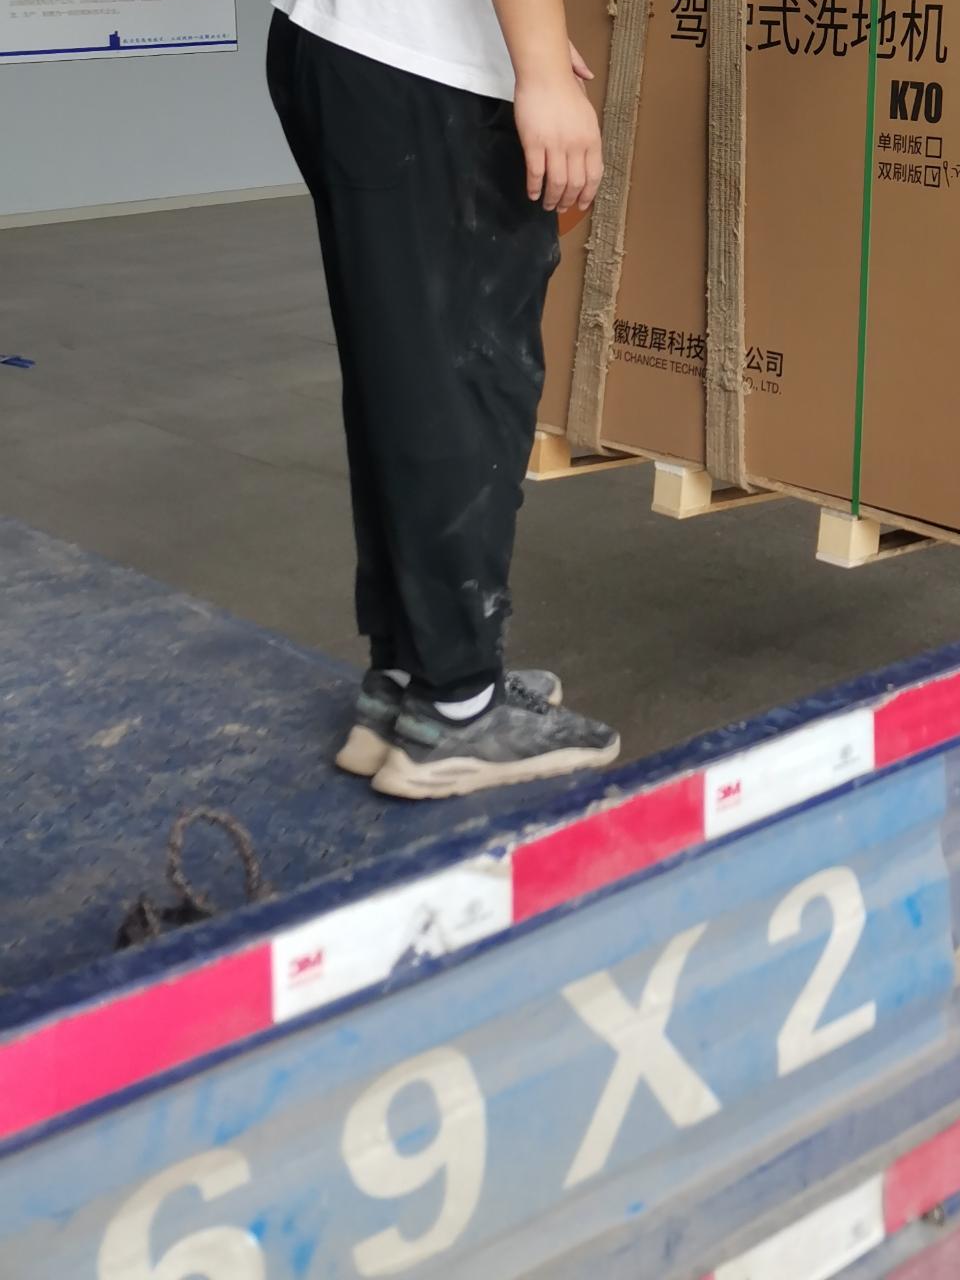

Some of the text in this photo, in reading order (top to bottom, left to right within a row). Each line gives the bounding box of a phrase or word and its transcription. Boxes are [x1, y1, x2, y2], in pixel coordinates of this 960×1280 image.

[889, 80, 943, 124] K70
[877, 132, 923, 155] 单刷版
[877, 162, 923, 184] 双刷版
[623, 351, 668, 371] CHANCEE
[761, 379, 783, 396] LTD.
